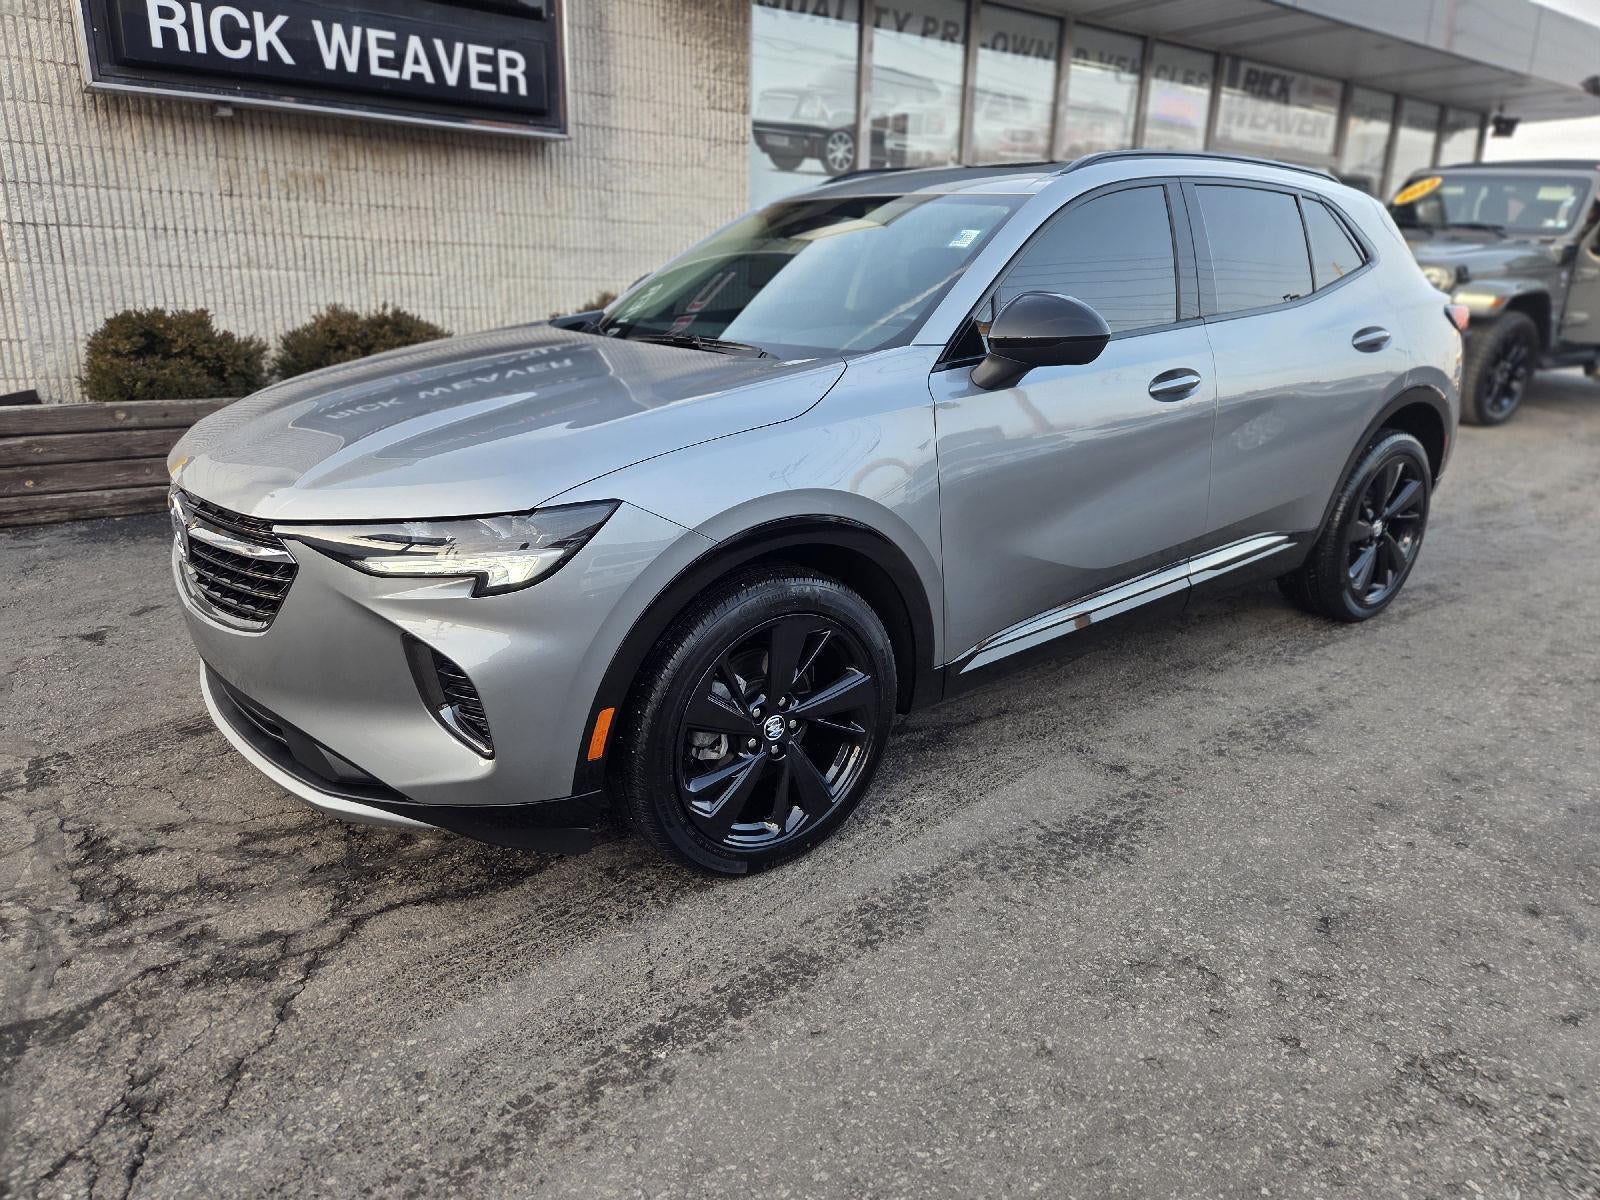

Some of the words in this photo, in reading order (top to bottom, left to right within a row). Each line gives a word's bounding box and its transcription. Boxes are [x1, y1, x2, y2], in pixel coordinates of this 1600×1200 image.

[146, 0, 296, 66] RICK
[311, 20, 528, 97] WEAVER
[1243, 67, 1296, 105] RICK
[1221, 96, 1331, 139] WEAVER
